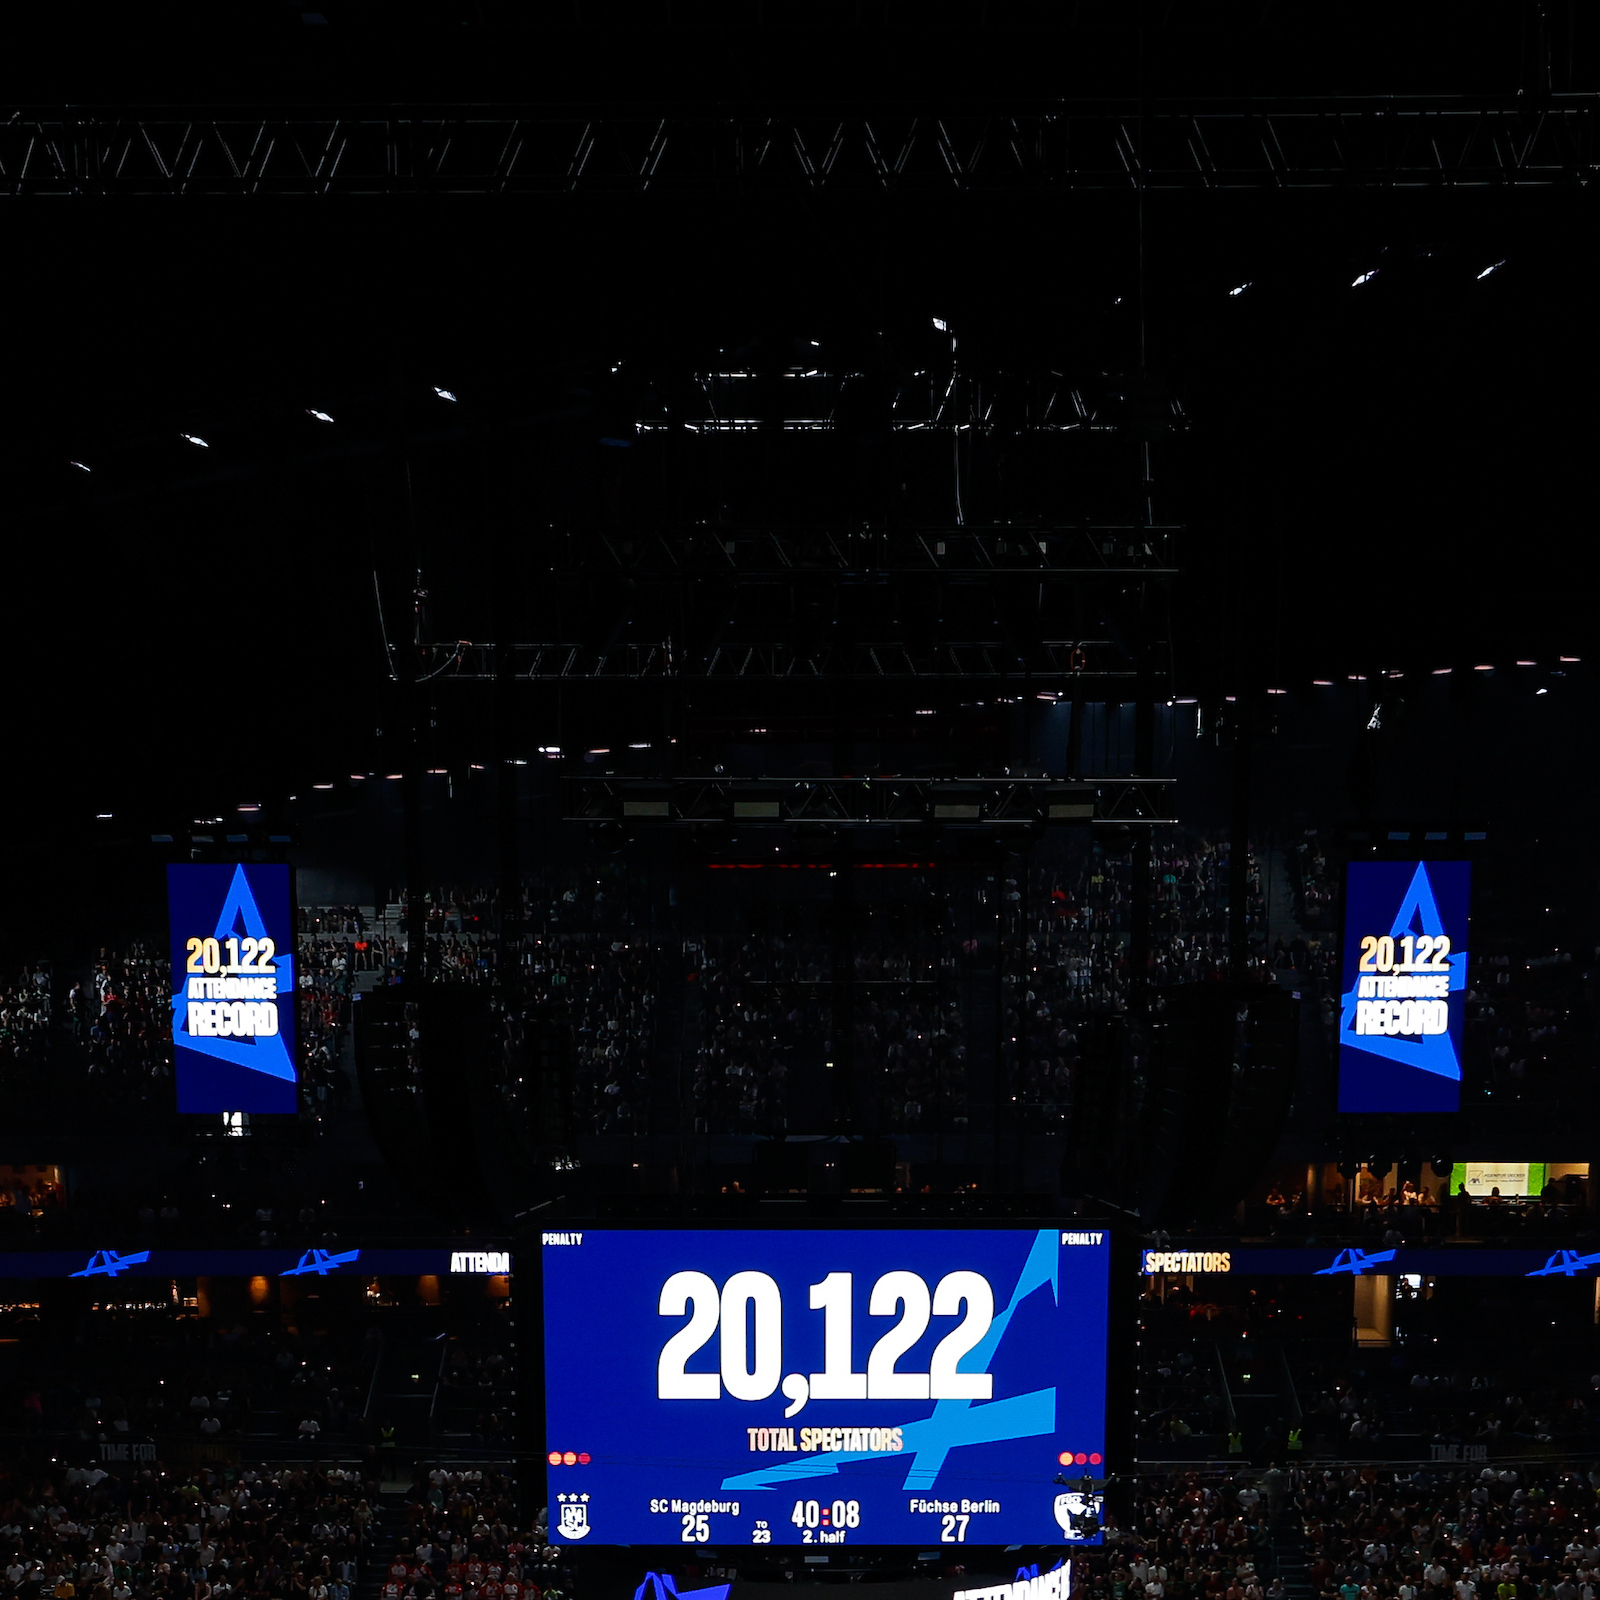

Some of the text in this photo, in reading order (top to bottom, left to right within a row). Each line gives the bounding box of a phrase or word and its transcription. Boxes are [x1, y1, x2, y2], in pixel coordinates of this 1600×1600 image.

[186, 937, 276, 978] 20,122
[1359, 935, 1451, 977] 20,122
[187, 977, 277, 1000] ATTENDANCE
[1357, 975, 1449, 998] ATTENDANCE
[188, 1001, 278, 1036] RECORD
[1356, 1000, 1448, 1036] RECORD
[542, 1233, 582, 1246] PENALTY
[1062, 1233, 1102, 1246] PENALTY
[1145, 1252, 1230, 1274] SPECTATORS
[657, 1270, 994, 1418] 20,122
[747, 1427, 903, 1452] TOTAL SPECTATORS
[650, 1499, 740, 1516] SC Magdeburg
[791, 1500, 860, 1528] 40:08
[909, 1499, 1000, 1513] Füchse Berlin
[681, 1514, 710, 1543] 25
[755, 1520, 768, 1529] TO
[941, 1514, 970, 1543] 27
[752, 1530, 771, 1544] 23
[803, 1530, 846, 1544] 2. half
